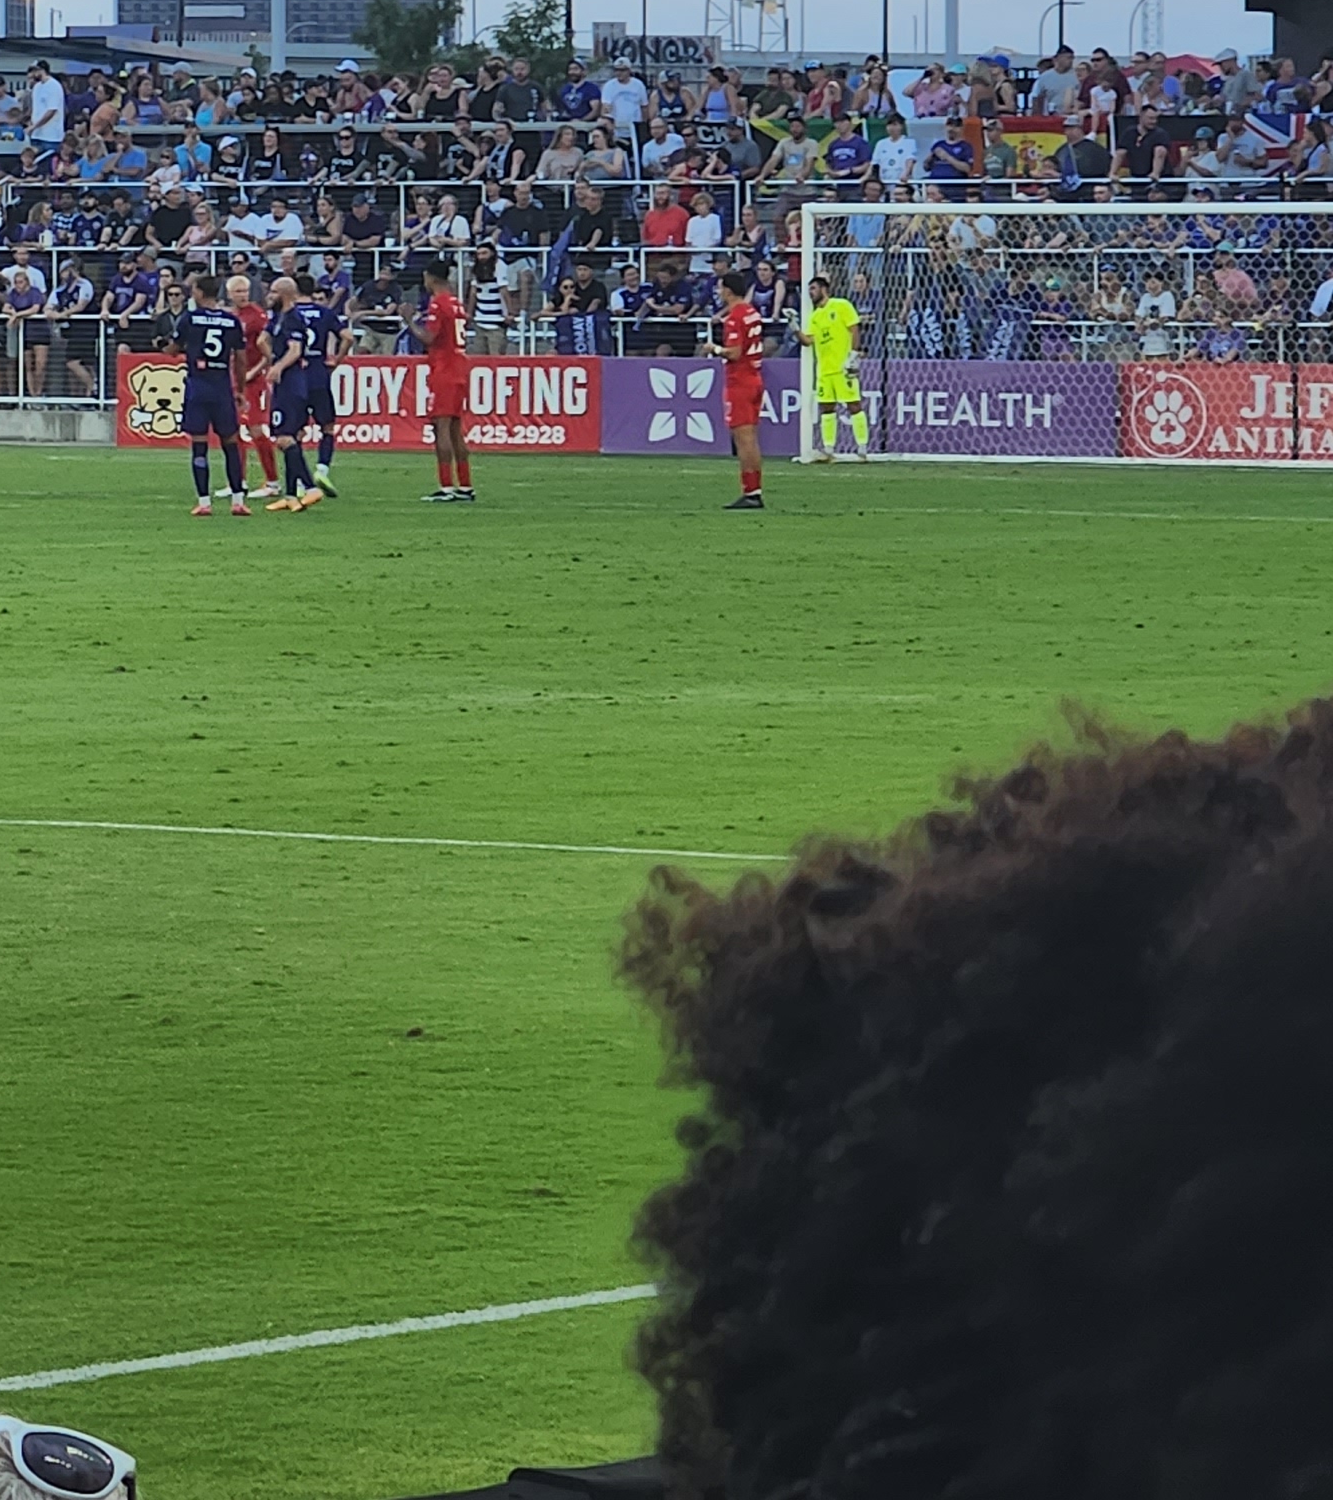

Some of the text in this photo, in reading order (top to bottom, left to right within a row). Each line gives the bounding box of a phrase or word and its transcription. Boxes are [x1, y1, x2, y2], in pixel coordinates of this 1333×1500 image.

[203, 328, 223, 357] 5
[415, 365, 588, 418] ROFING
[896, 390, 1052, 428] HEALTH
[422, 424, 566, 445] 5.425.2928
